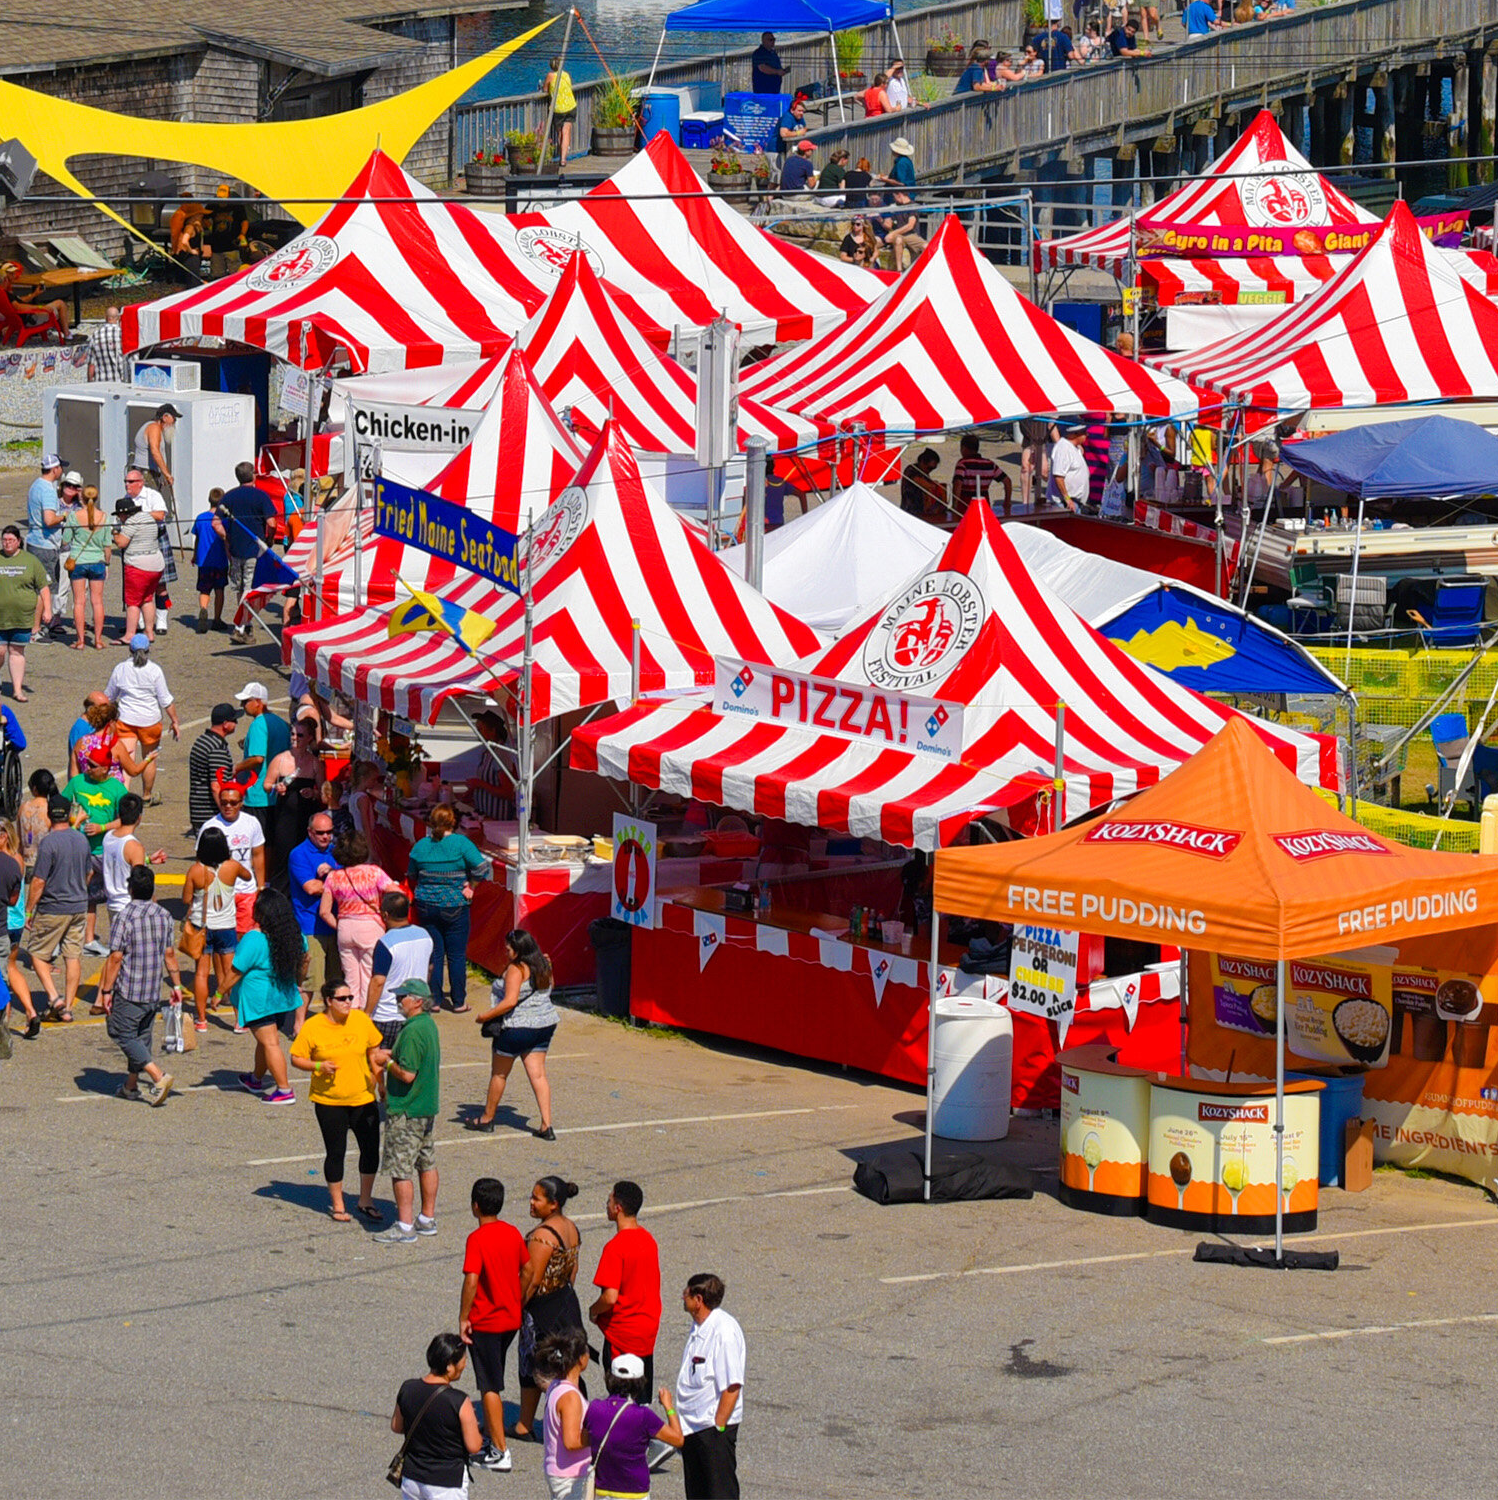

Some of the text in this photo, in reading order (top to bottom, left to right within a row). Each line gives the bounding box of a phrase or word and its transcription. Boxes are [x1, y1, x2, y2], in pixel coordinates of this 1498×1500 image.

[1162, 229, 1208, 250] Gyro
[1211, 234, 1230, 251] in
[1233, 239, 1242, 251] a
[1247, 234, 1283, 252] Pita
[1324, 231, 1370, 249] Giant
[265, 237, 336, 274] MAINE LOBSTER
[1239, 293, 1286, 304] VEGGIE
[375, 484, 415, 540] Fried
[418, 500, 456, 556] Maine
[460, 517, 519, 588] Seafood
[881, 578, 978, 651] MAINE LOBSTER
[867, 657, 937, 687] FESTIVAL
[722, 700, 759, 717] Domino's
[770, 672, 910, 747] PIZZA!
[916, 740, 952, 758] Domino's
[1091, 822, 1235, 856] KOZYSHACK
[1281, 831, 1388, 858] KOZYSHACK
[1007, 884, 1207, 935] FREE PUDDING
[1337, 887, 1478, 936] FREE PUDDING
[1025, 925, 1062, 947] PIZZA
[1012, 935, 1077, 968] PEPPERONI
[1032, 956, 1049, 973] OR
[1015, 965, 1065, 994] CHEESE
[1292, 962, 1369, 995] KOZYSHACK
[1392, 975, 1437, 990] OZYSHACK
[1011, 980, 1059, 1007] $2.00 A
[1046, 999, 1074, 1017] SLICE
[1202, 1106, 1266, 1120] KOZYSHACK
